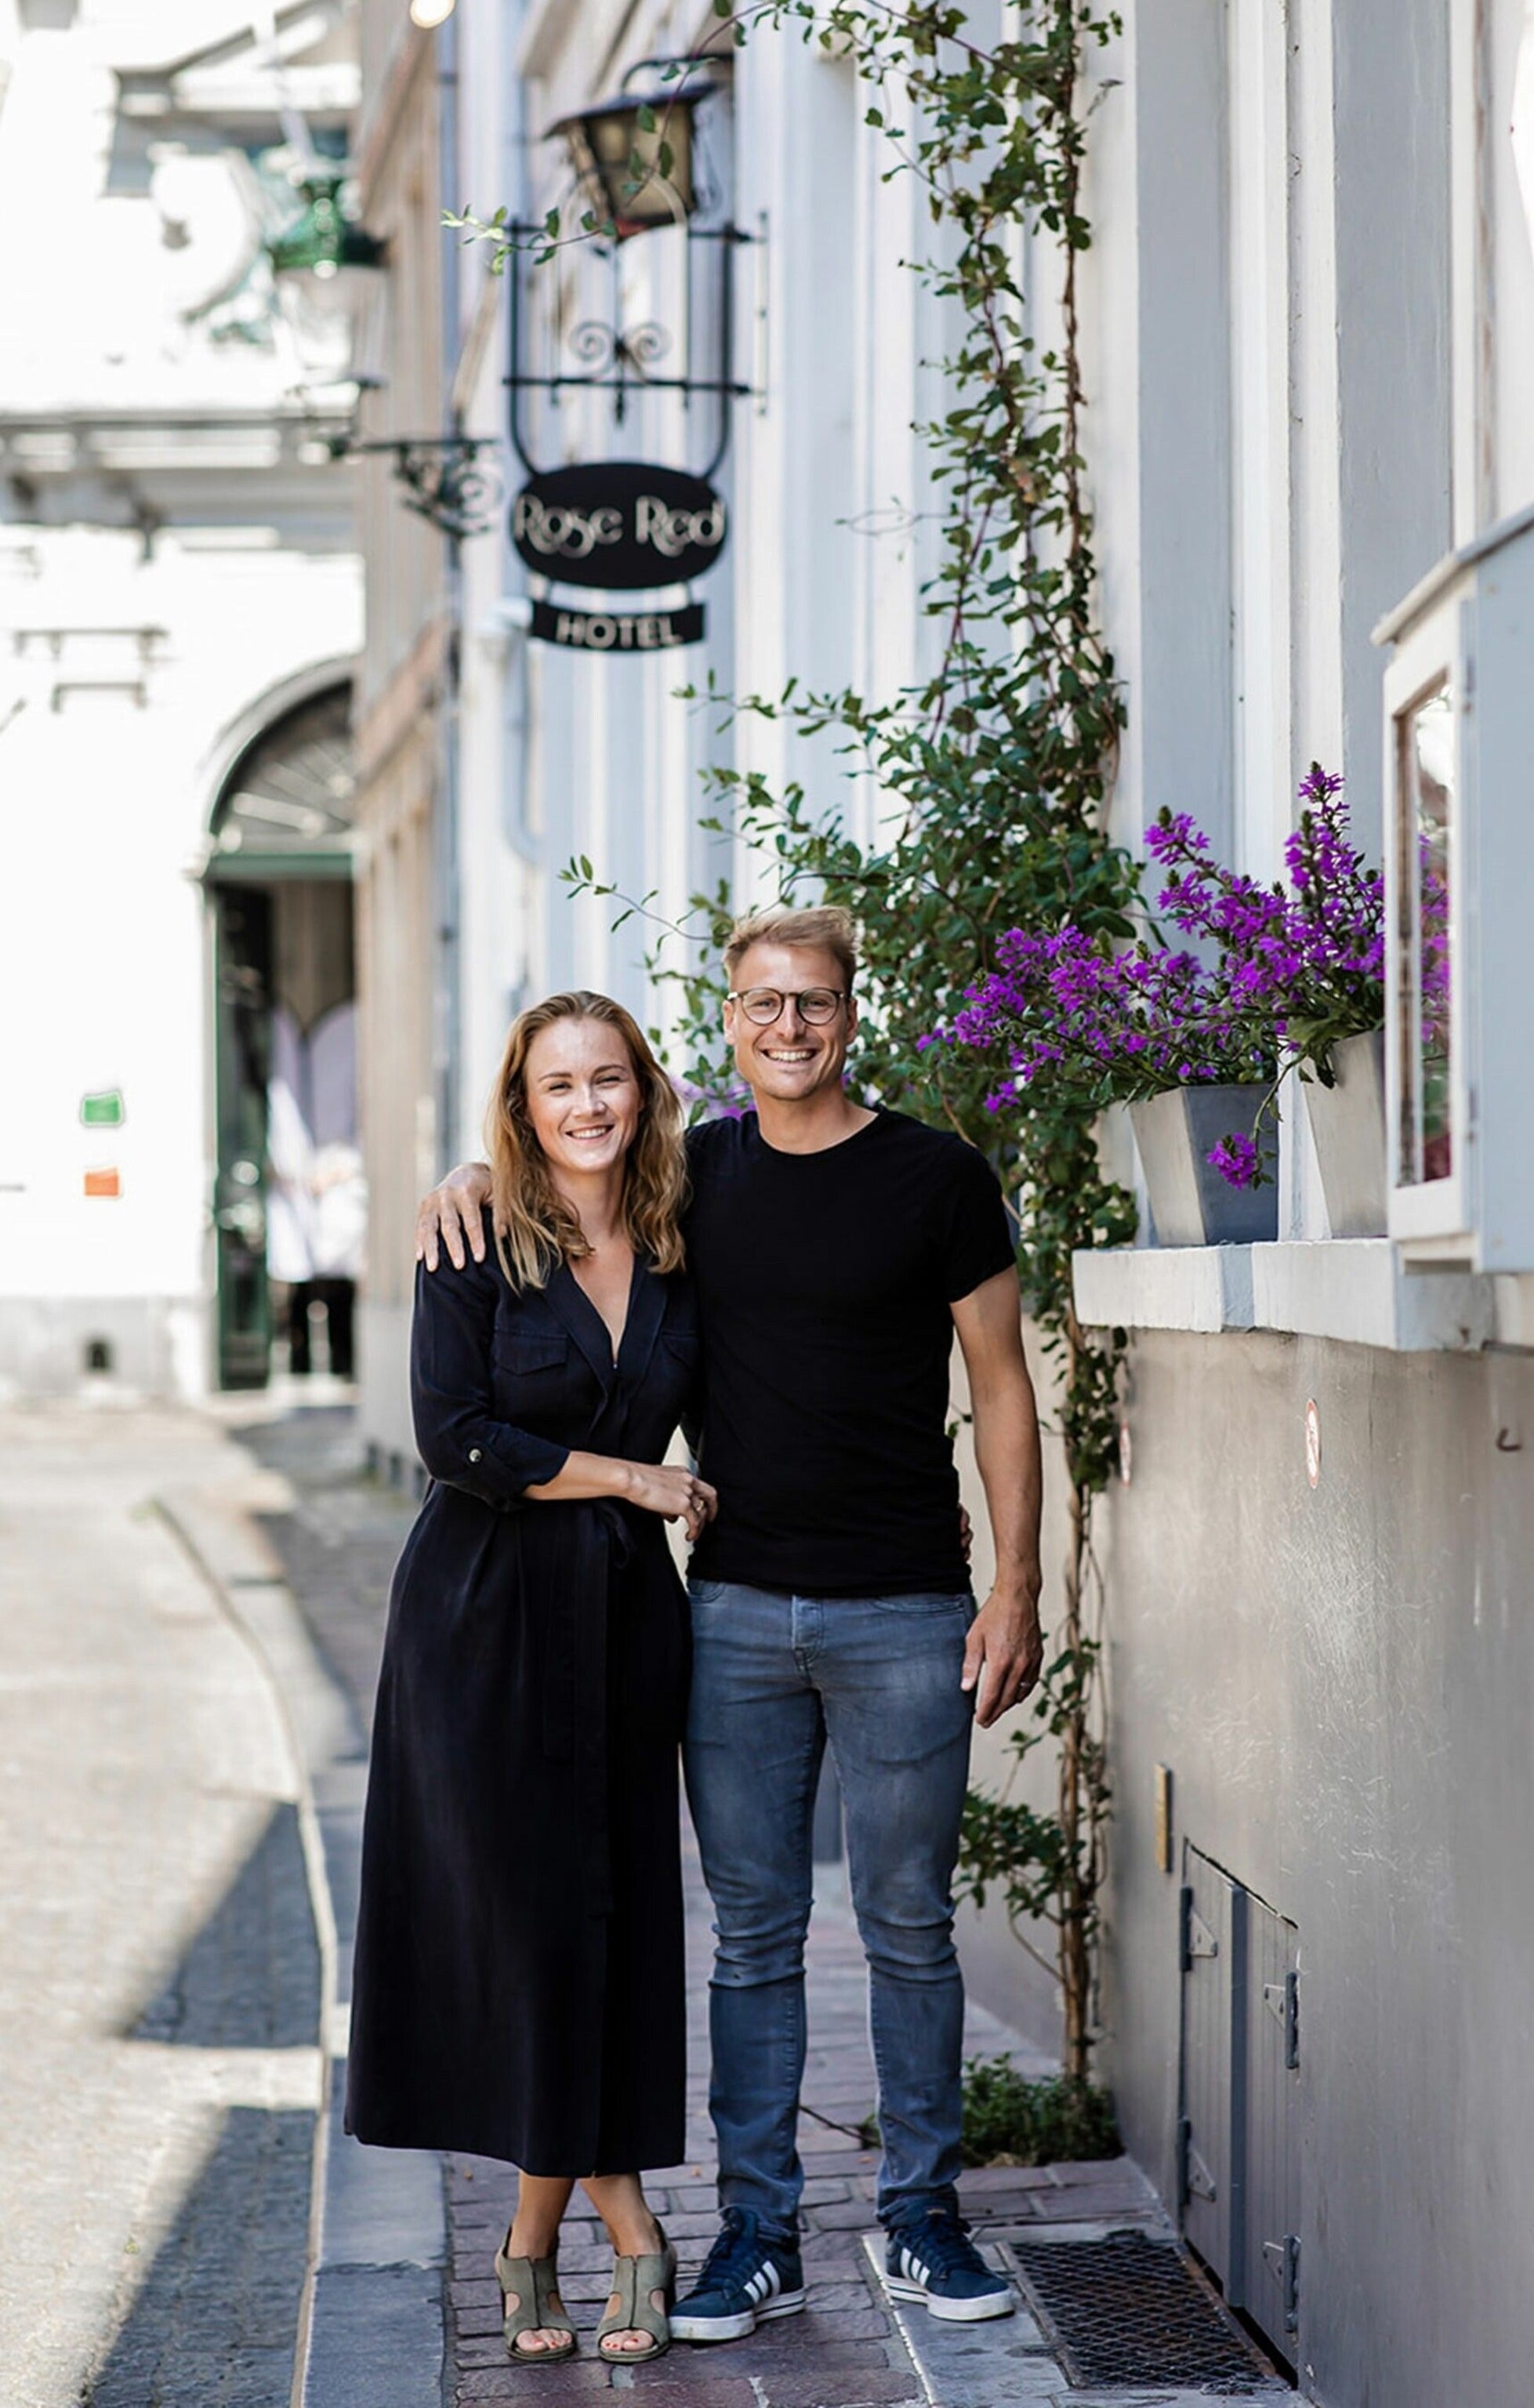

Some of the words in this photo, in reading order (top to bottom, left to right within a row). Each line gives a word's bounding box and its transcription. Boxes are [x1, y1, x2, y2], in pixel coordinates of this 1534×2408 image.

[514, 495, 623, 558] Rose
[636, 495, 725, 557] Red
[556, 614, 684, 648] HOTEL
